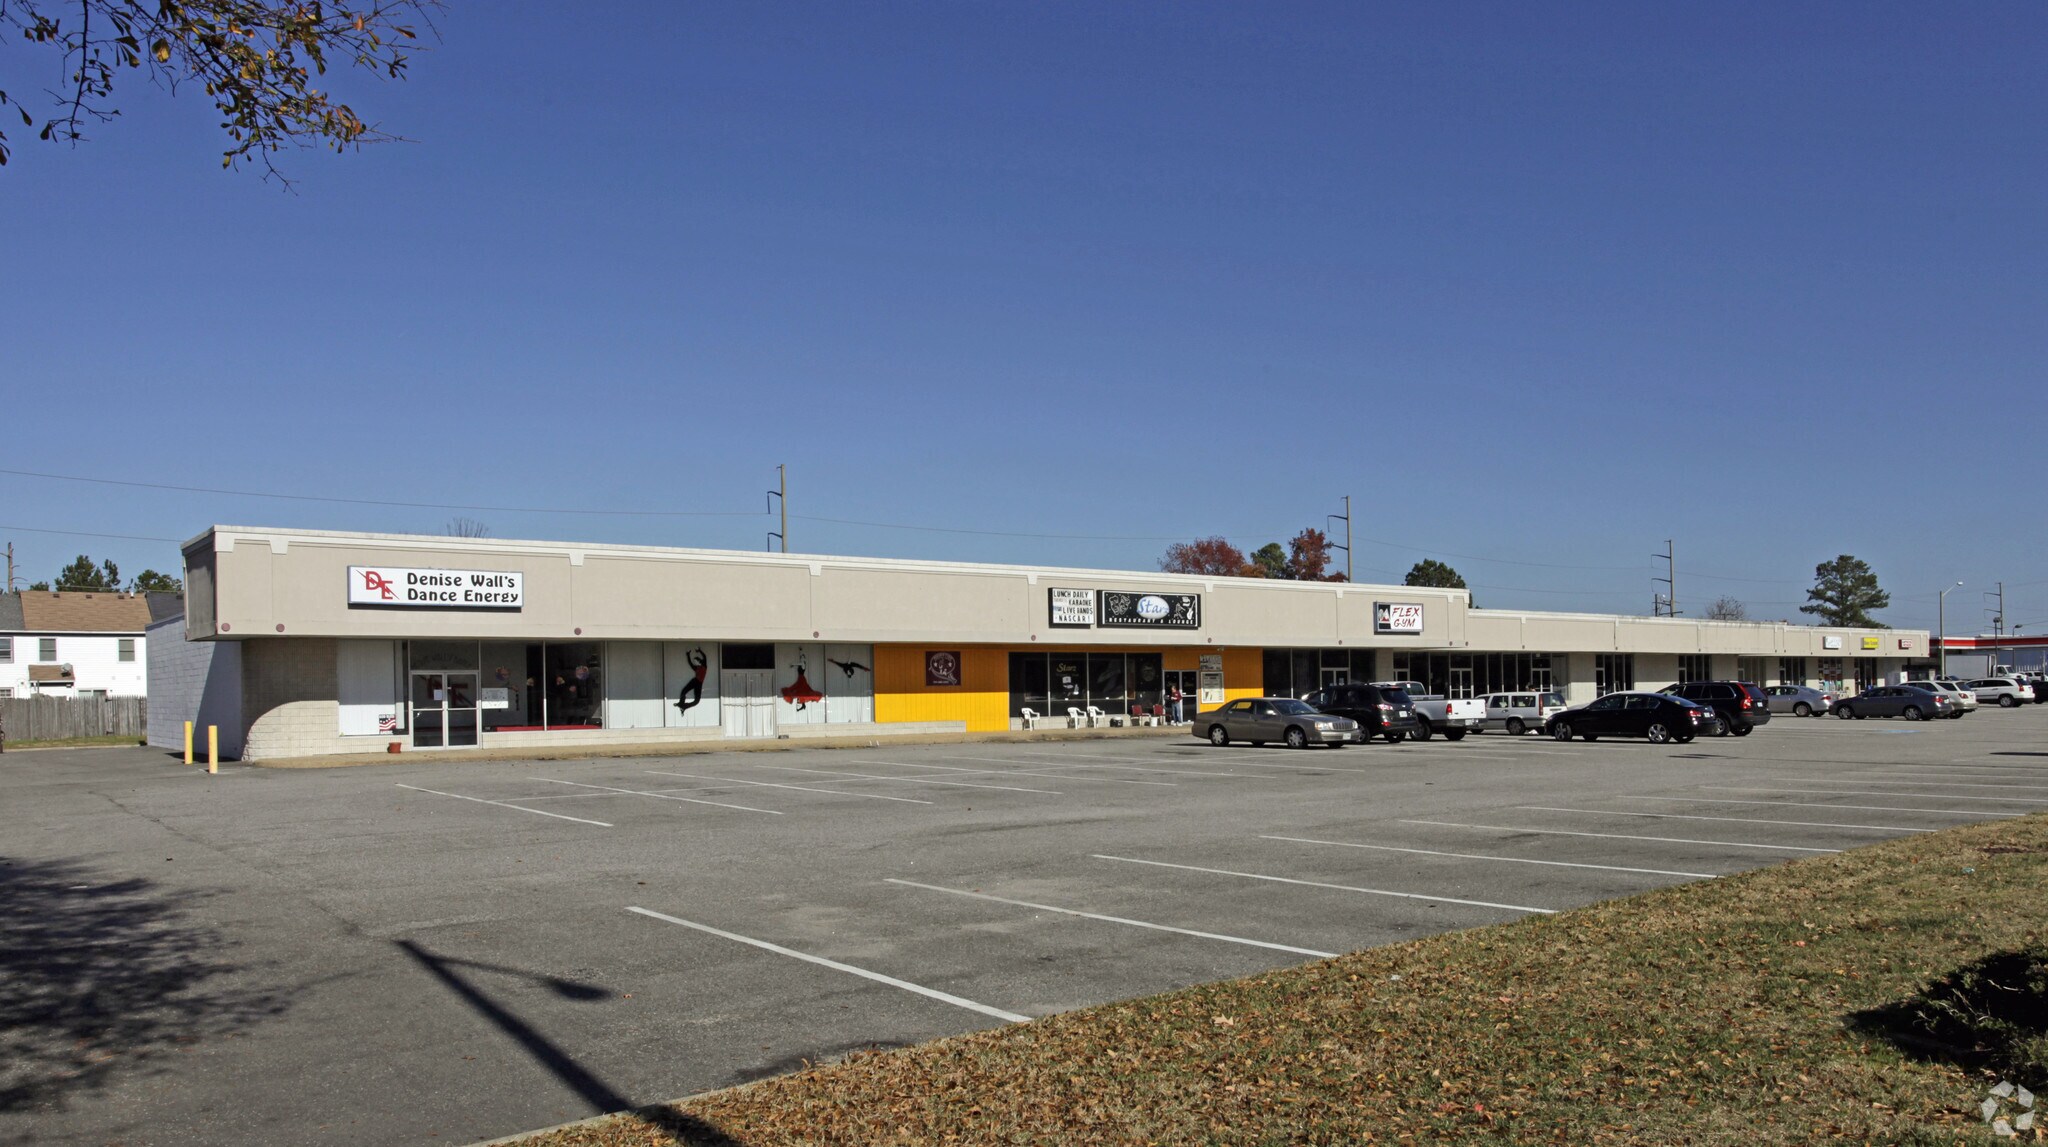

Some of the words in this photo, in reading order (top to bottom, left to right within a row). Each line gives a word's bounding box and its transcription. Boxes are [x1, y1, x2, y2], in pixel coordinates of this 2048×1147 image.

[407, 572, 462, 587] Denise
[470, 574, 515, 588] Wall's
[407, 588, 457, 602] Dance
[464, 589, 519, 603] Energy
[1053, 590, 1071, 598] LUNCH
[1068, 599, 1092, 607] KARAOKE
[1062, 606, 1076, 615] LIVE
[1076, 607, 1093, 615] BANDS
[1392, 607, 1419, 617] FLEX
[1394, 618, 1415, 627] GYM
